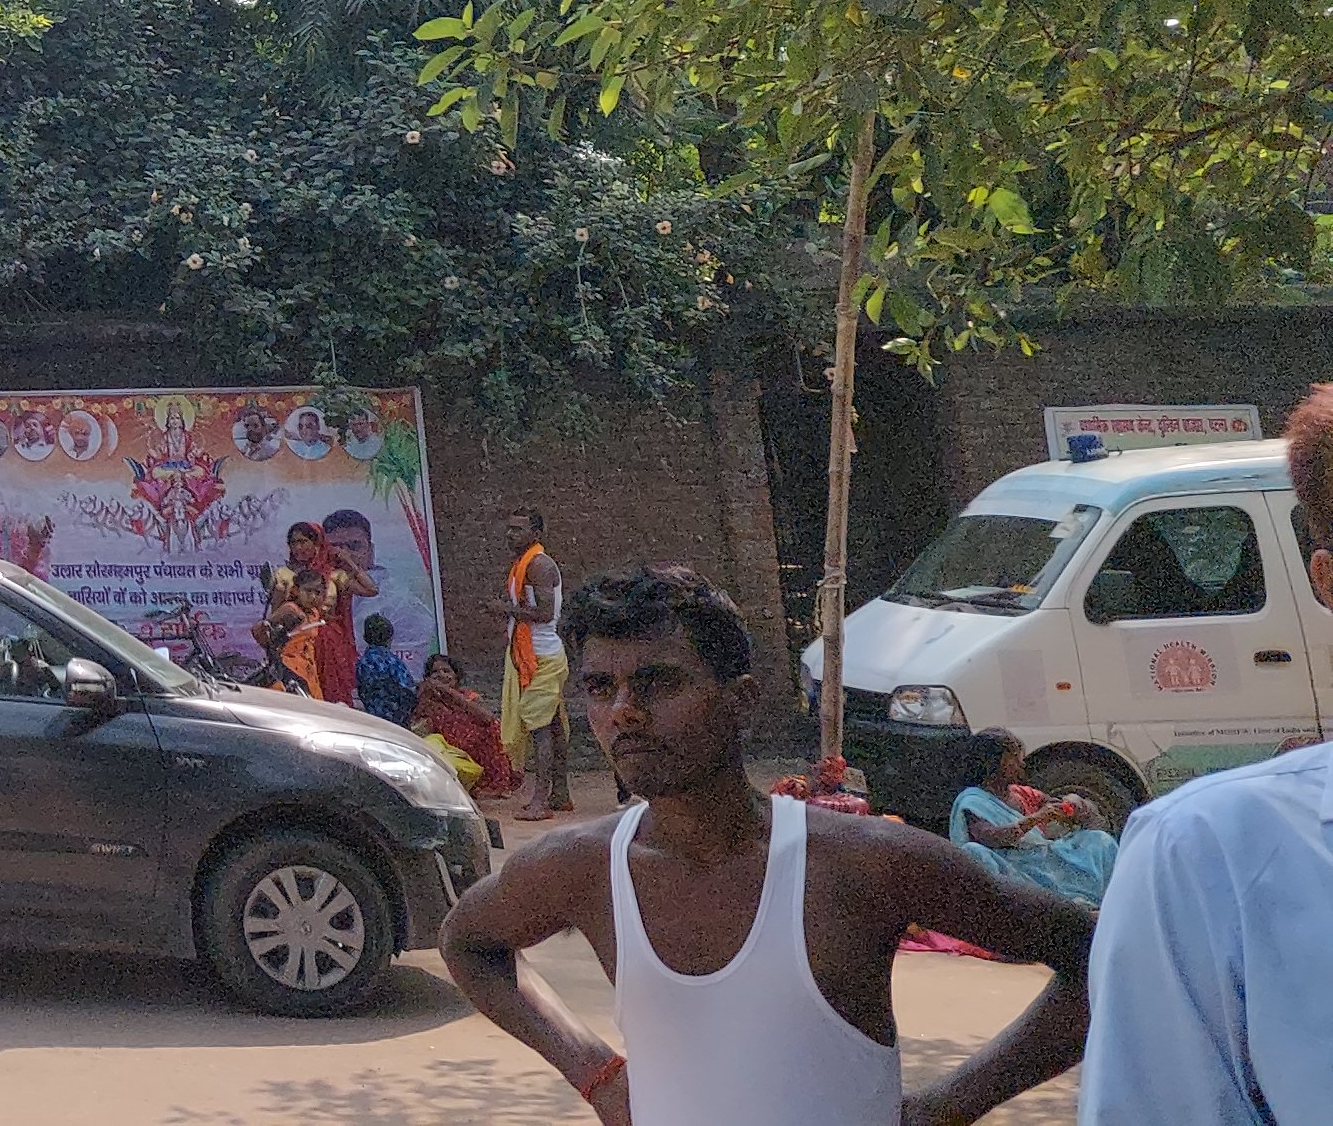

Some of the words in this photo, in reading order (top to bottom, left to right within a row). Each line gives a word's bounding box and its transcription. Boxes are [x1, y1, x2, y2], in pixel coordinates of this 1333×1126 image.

[153, 560, 196, 578] पंचायत
[199, 560, 213, 578] के
[216, 559, 244, 578] सभी
[129, 587, 148, 606] को
[212, 586, 257, 606] महापर्व
[1148, 648, 1164, 692] NATIONAL
[1163, 640, 1197, 651] HEALTH
[1199, 647, 1219, 686] MISSION
